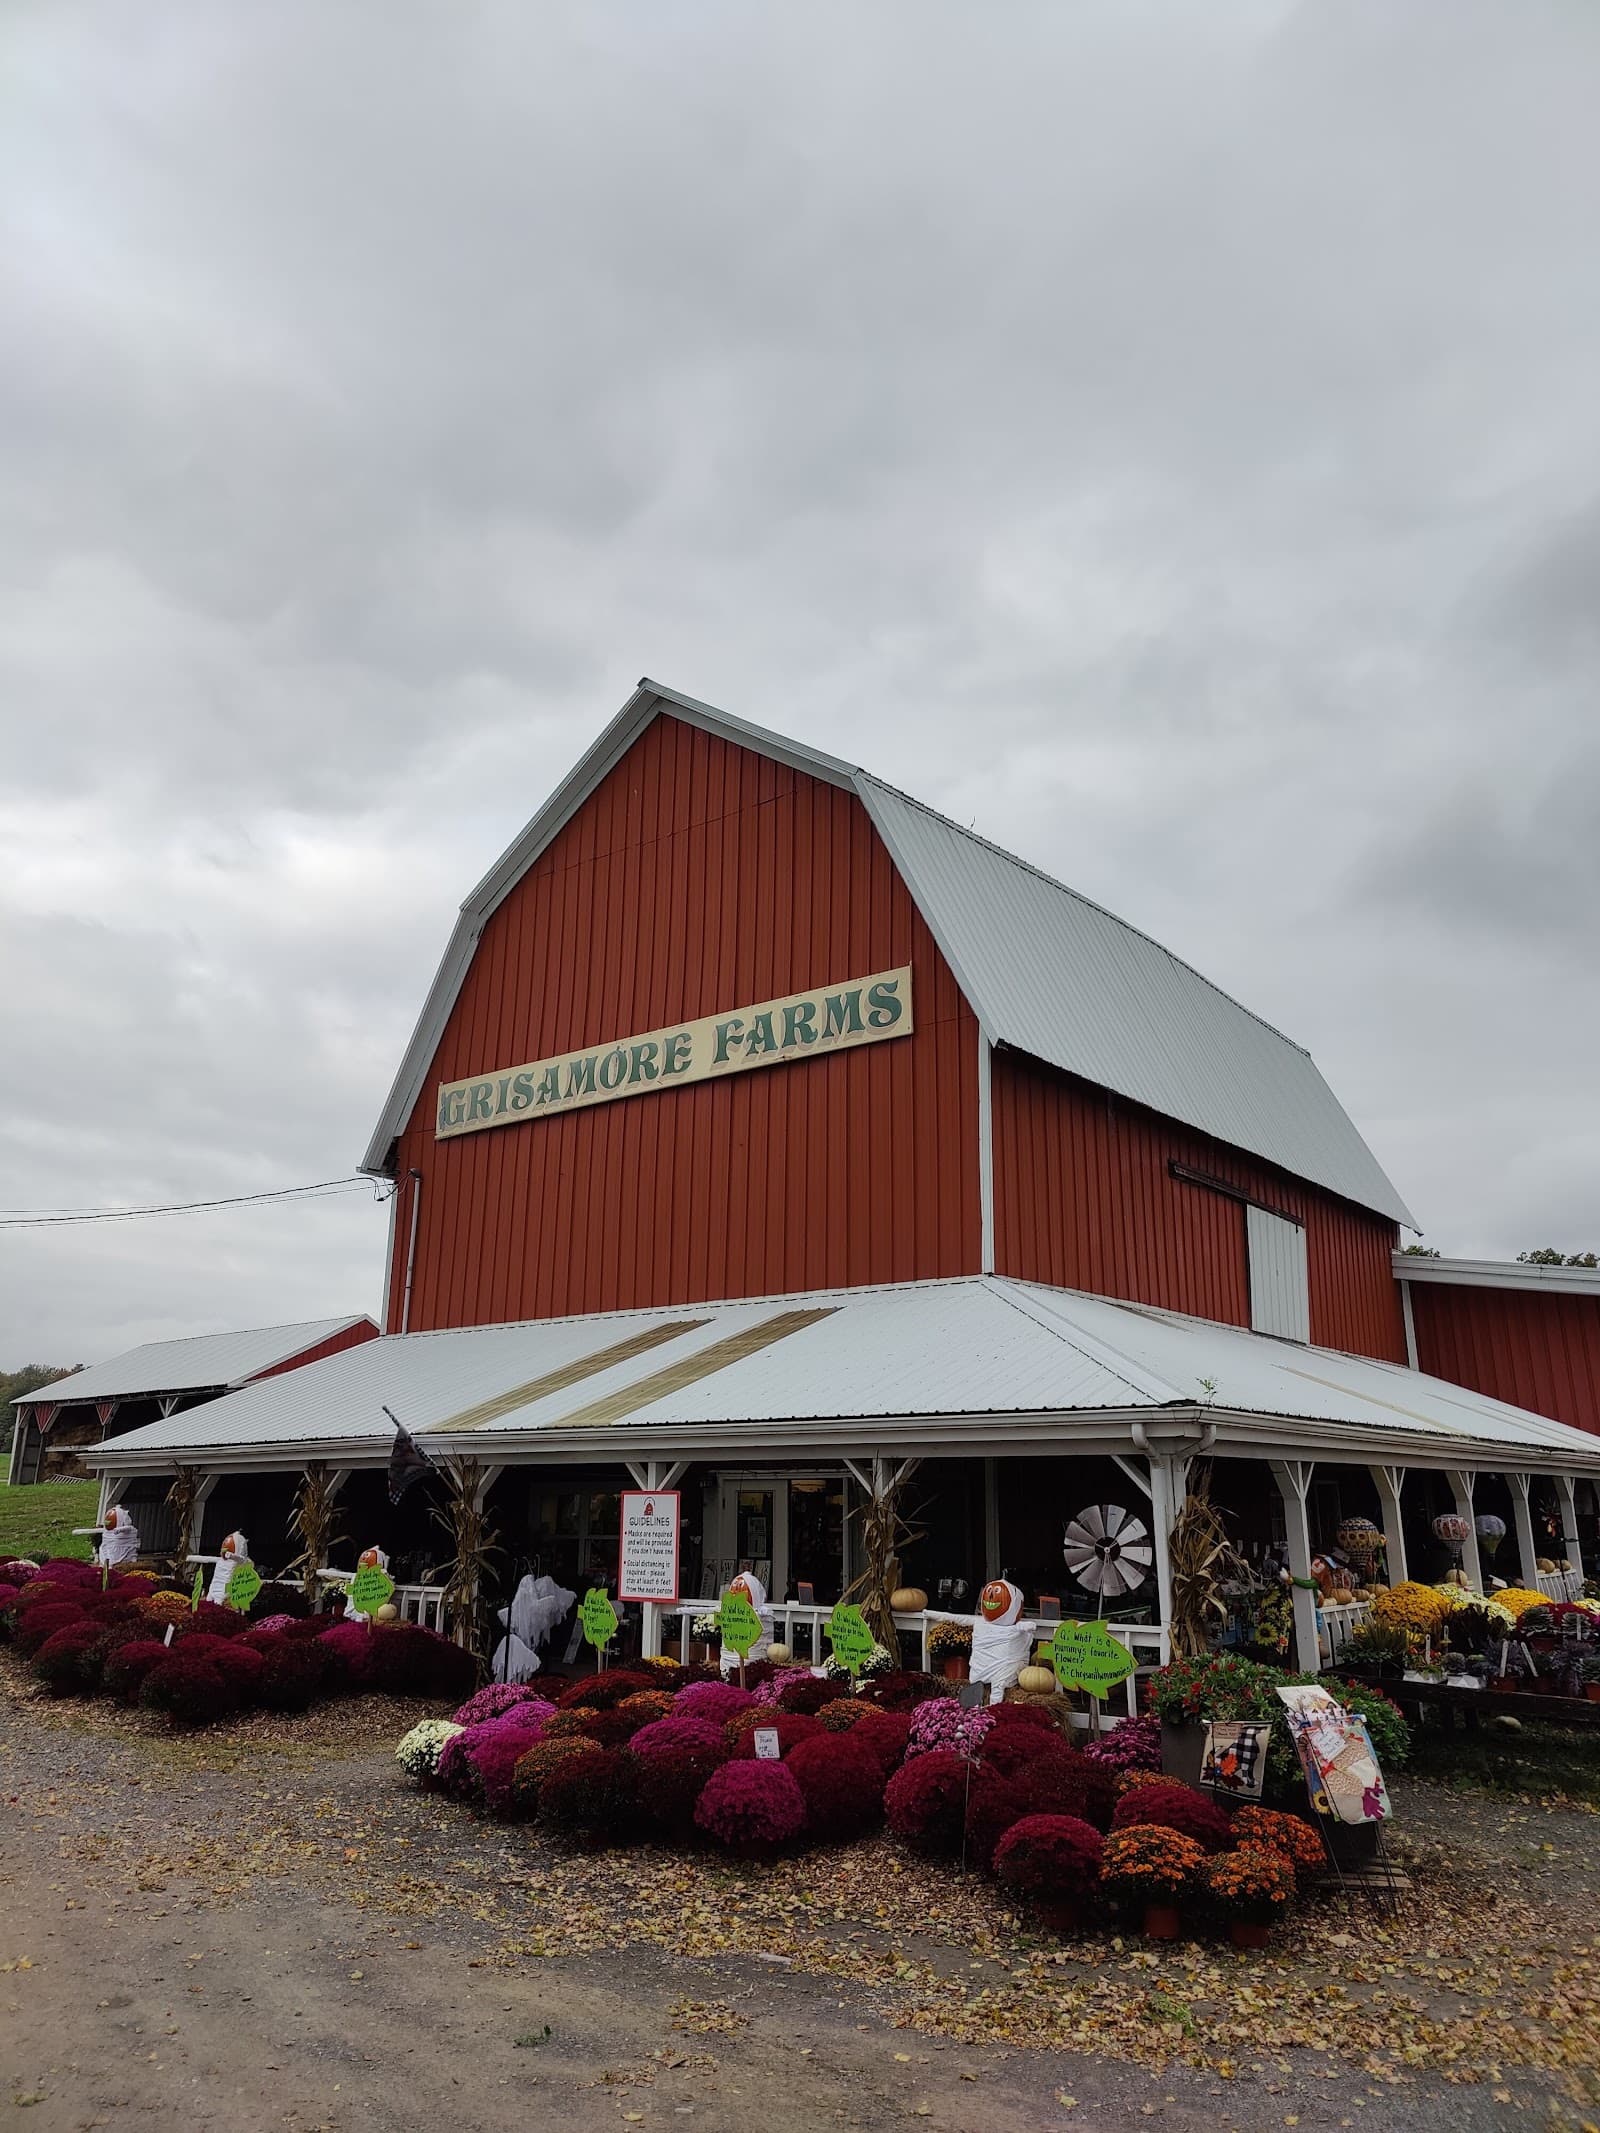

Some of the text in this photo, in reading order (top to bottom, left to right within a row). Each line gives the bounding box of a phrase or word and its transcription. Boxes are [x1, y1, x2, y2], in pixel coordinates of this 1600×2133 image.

[440, 979, 903, 1127] GRISAMORE FARMS
[629, 1517, 670, 1526] GUIDELINES
[652, 1531, 673, 1539] required
[651, 1539, 673, 1547] provided
[627, 1559, 640, 1567] Social
[641, 1560, 665, 1569] distancing
[626, 1569, 646, 1577] required
[660, 1578, 671, 1586] feet
[656, 1588, 673, 1596] person
[1074, 1631, 1092, 1643] What
[1096, 1636, 1103, 1646] is
[1105, 1640, 1111, 1648] a
[1054, 1643, 1120, 1660] mummy's favorite
